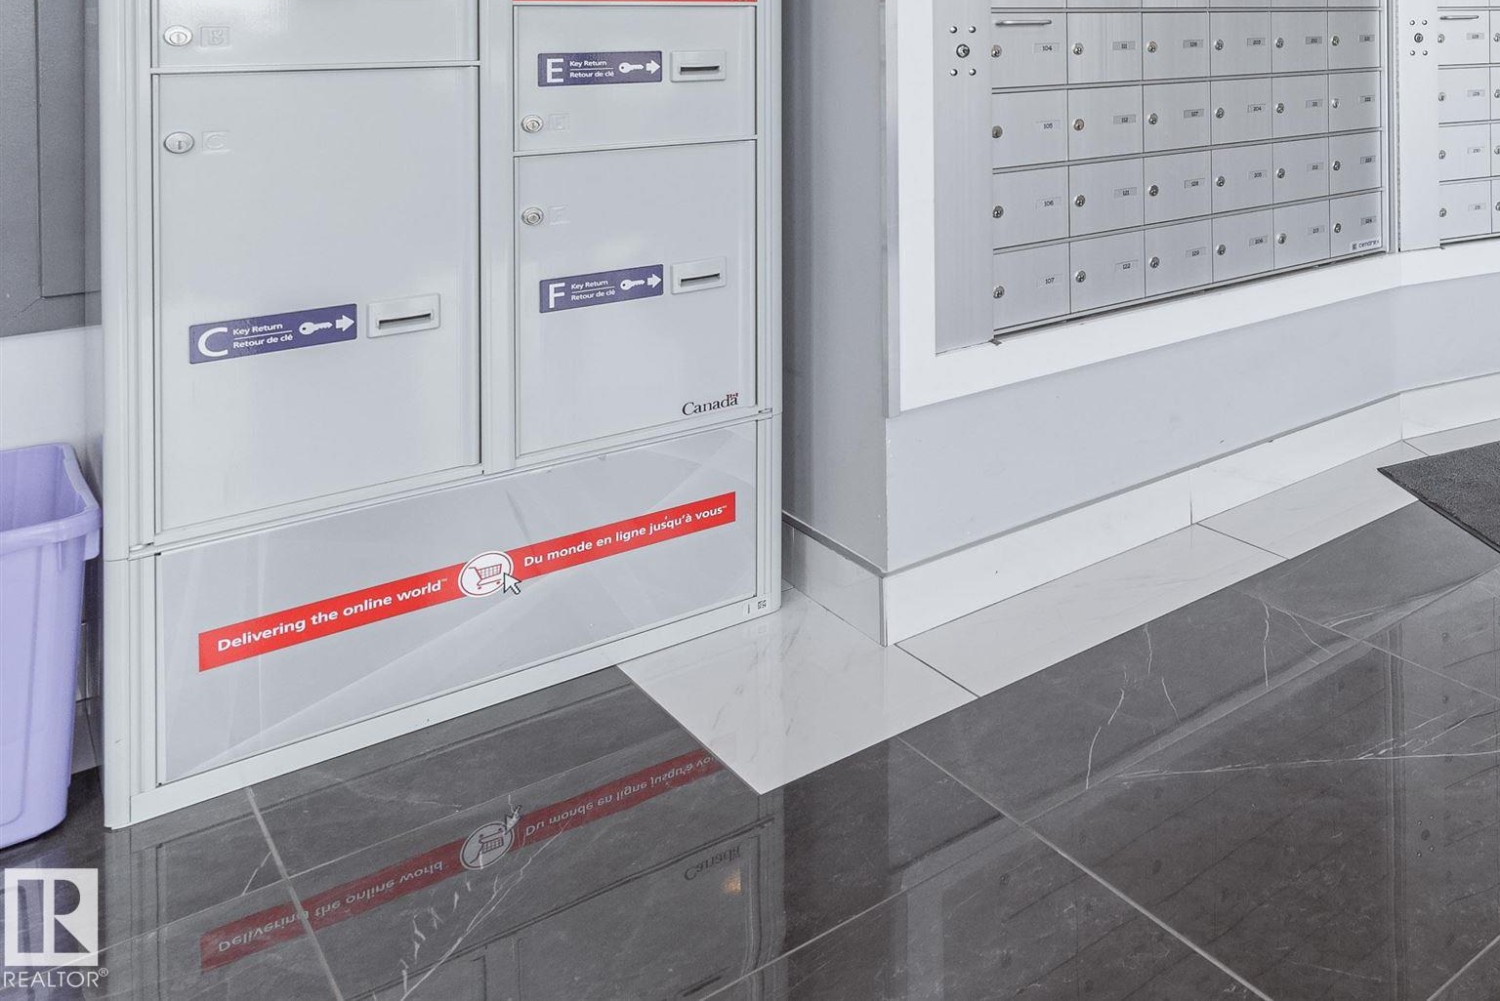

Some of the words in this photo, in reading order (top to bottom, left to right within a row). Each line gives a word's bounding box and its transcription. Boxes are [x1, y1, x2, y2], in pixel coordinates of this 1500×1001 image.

[547, 58, 564, 84] E
[569, 60, 583, 69] Key
[570, 71, 594, 79] Retour
[571, 283, 584, 291] Key
[585, 280, 609, 288] Return
[549, 282, 566, 309] F
[571, 293, 595, 302] Retour
[606, 289, 616, 297] clé
[233, 328, 250, 337] Key
[252, 323, 283, 333] Return
[198, 327, 229, 358] C
[233, 338, 265, 349] Retour
[267, 335, 279, 344] de
[280, 333, 294, 342] clé
[682, 394, 739, 416] Canada
[524, 554, 544, 567] Du
[547, 540, 593, 562] monde
[596, 536, 612, 547] en
[615, 526, 647, 545] ligne
[217, 618, 306, 652] Delivering
[310, 609, 339, 626] the
[343, 595, 392, 617] online
